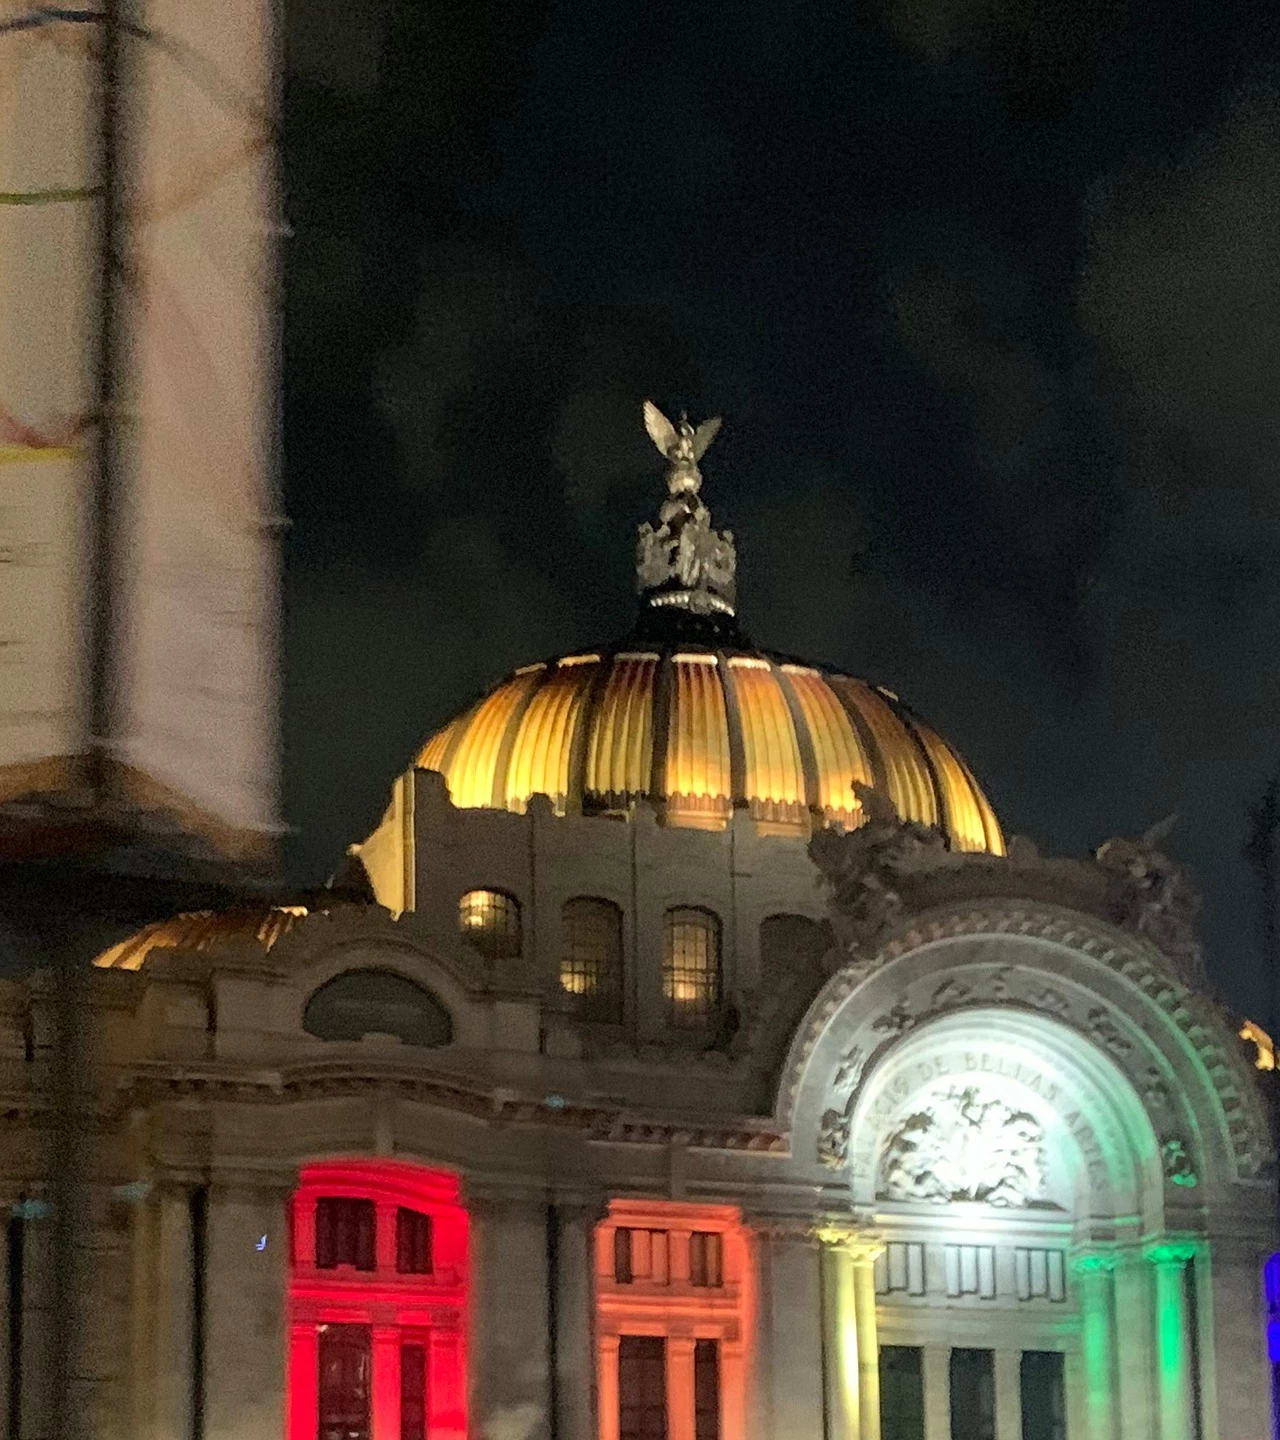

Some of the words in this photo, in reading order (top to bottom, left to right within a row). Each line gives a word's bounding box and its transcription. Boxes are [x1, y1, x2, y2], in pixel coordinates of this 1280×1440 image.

[918, 1055, 951, 1081] DE
[963, 1052, 1063, 1101] BELLAS
[1063, 1110, 1110, 1191] ARTES
